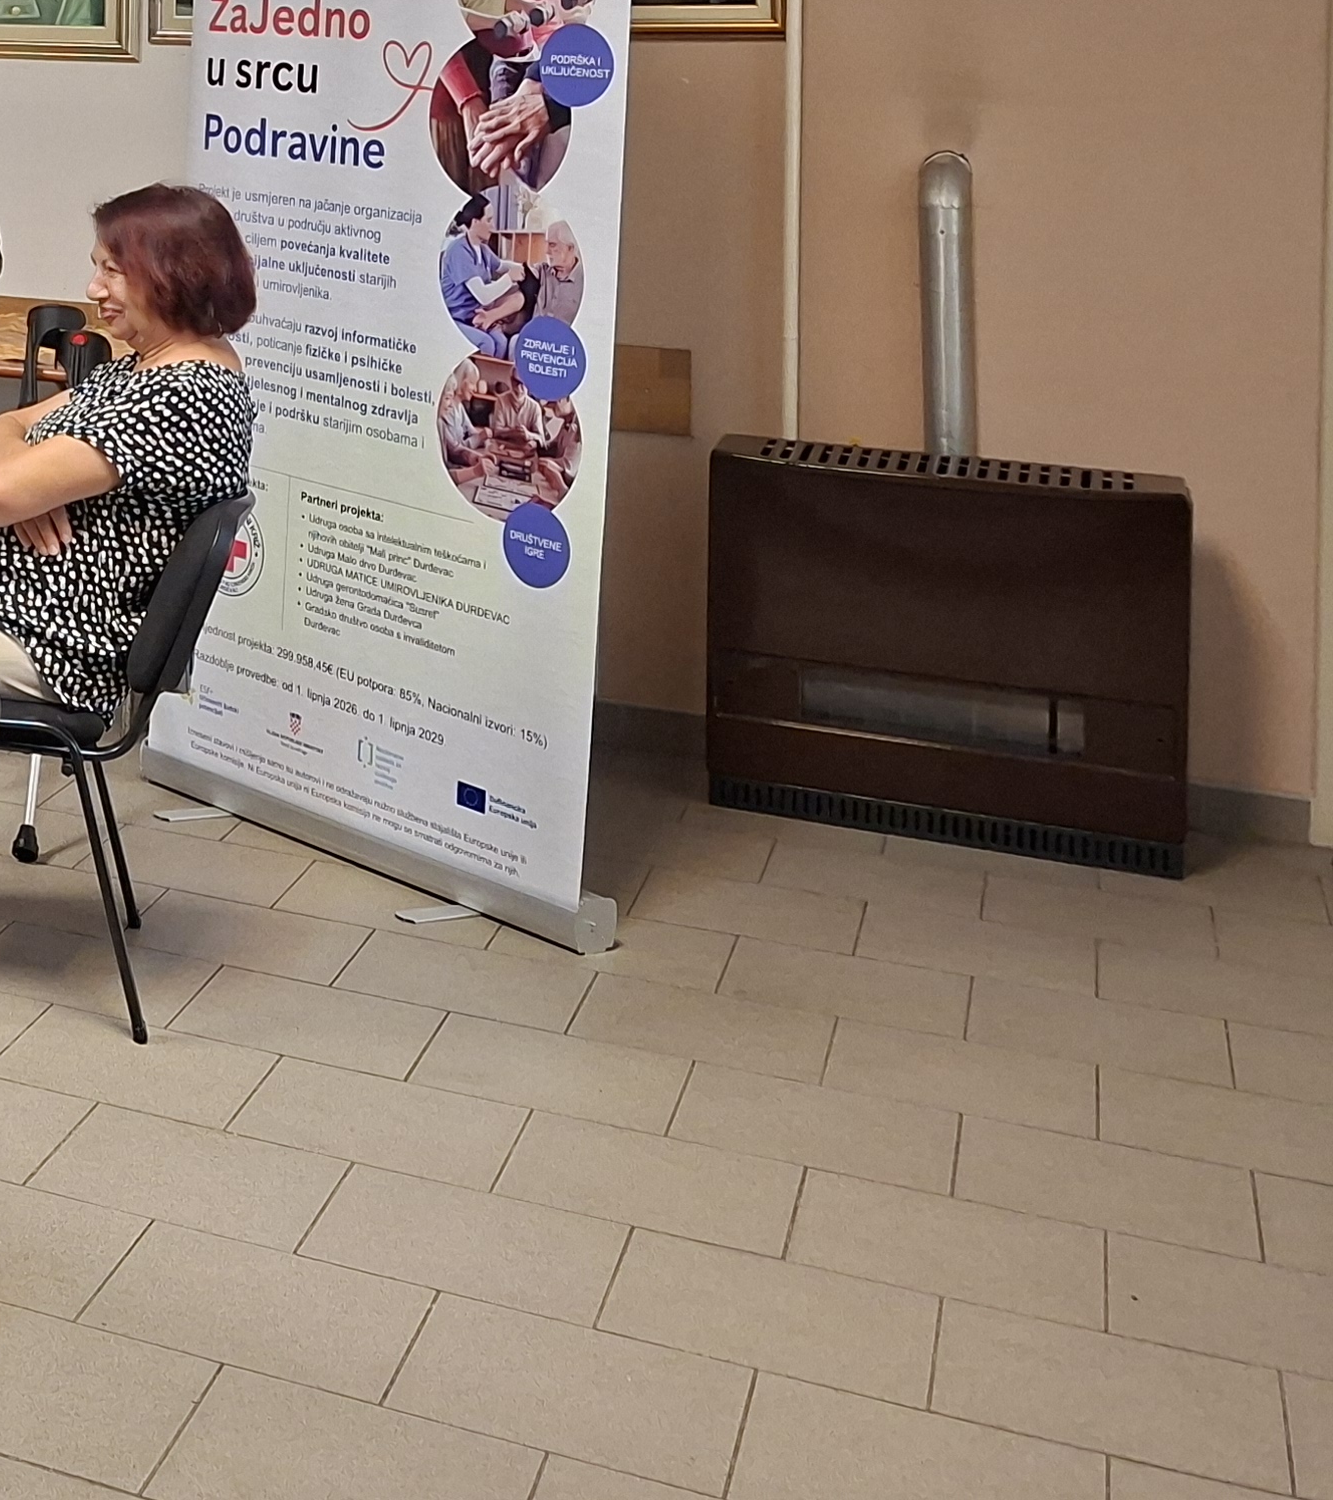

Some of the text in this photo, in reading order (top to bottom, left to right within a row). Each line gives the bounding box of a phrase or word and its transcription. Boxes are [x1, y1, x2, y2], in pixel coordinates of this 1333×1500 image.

[207, 57, 318, 94] u srcu
[541, 65, 611, 79] UKLJUČENOST
[550, 54, 596, 66] PODRŠKA
[204, 113, 386, 169] Podravine
[231, 188, 242, 202] je
[244, 191, 296, 207] usmjeren
[299, 197, 312, 209] na
[314, 198, 351, 214] jačanje
[353, 205, 423, 226] organizacija
[234, 209, 382, 244] društva u području aktivnog
[244, 232, 390, 265] ciljem povećanja kvalitete
[262, 279, 333, 301] umirovljenika.
[288, 260, 356, 283] uključenosti
[359, 272, 397, 290] starijih
[304, 322, 338, 342] razvoj
[341, 328, 417, 354] informatičke
[523, 338, 570, 355] ZDRAVLJE
[256, 336, 303, 356] poticanje
[305, 343, 342, 362] fizičke
[351, 354, 403, 375] psihičke
[520, 349, 578, 368] PREVENCIJA
[528, 362, 567, 378] BOLESTI
[244, 356, 303, 378] prevenciju
[305, 369, 381, 393] usamljenosti
[390, 382, 436, 407] bolesti,
[306, 390, 368, 416] mentalnog
[371, 404, 419, 426] zdravlja
[275, 405, 320, 426] podršku
[322, 414, 363, 436] starijim
[365, 423, 418, 449] osobama
[300, 491, 384, 523] Partneri projekta:
[308, 513, 337, 530] Udruga
[338, 522, 364, 537] osoba
[365, 530, 375, 540] sa
[509, 529, 562, 553] DRUŠTVENE
[307, 543, 336, 560] Udruga
[337, 551, 357, 566] Malo
[358, 557, 377, 571] drvo
[524, 546, 546, 560] IGRE
[306, 571, 334, 589] Udruga
[307, 557, 344, 577] UDRUGA
[345, 569, 378, 587] MATICE
[380, 579, 455, 609] UMIROVLJENIKA
[305, 586, 333, 603] Udruga
[335, 594, 355, 609] žena
[357, 602, 382, 618] Grada
[237, 635, 275, 655] projekta:
[335, 666, 355, 683] (EU
[357, 675, 396, 696] potpora:
[427, 697, 483, 726] Nacionalni
[485, 716, 516, 737] izvori:
[520, 727, 549, 750] 15%)
[281, 680, 294, 693] od
[307, 688, 331, 707] lipnja
[362, 706, 376, 722] do
[389, 716, 416, 737] lipnja
